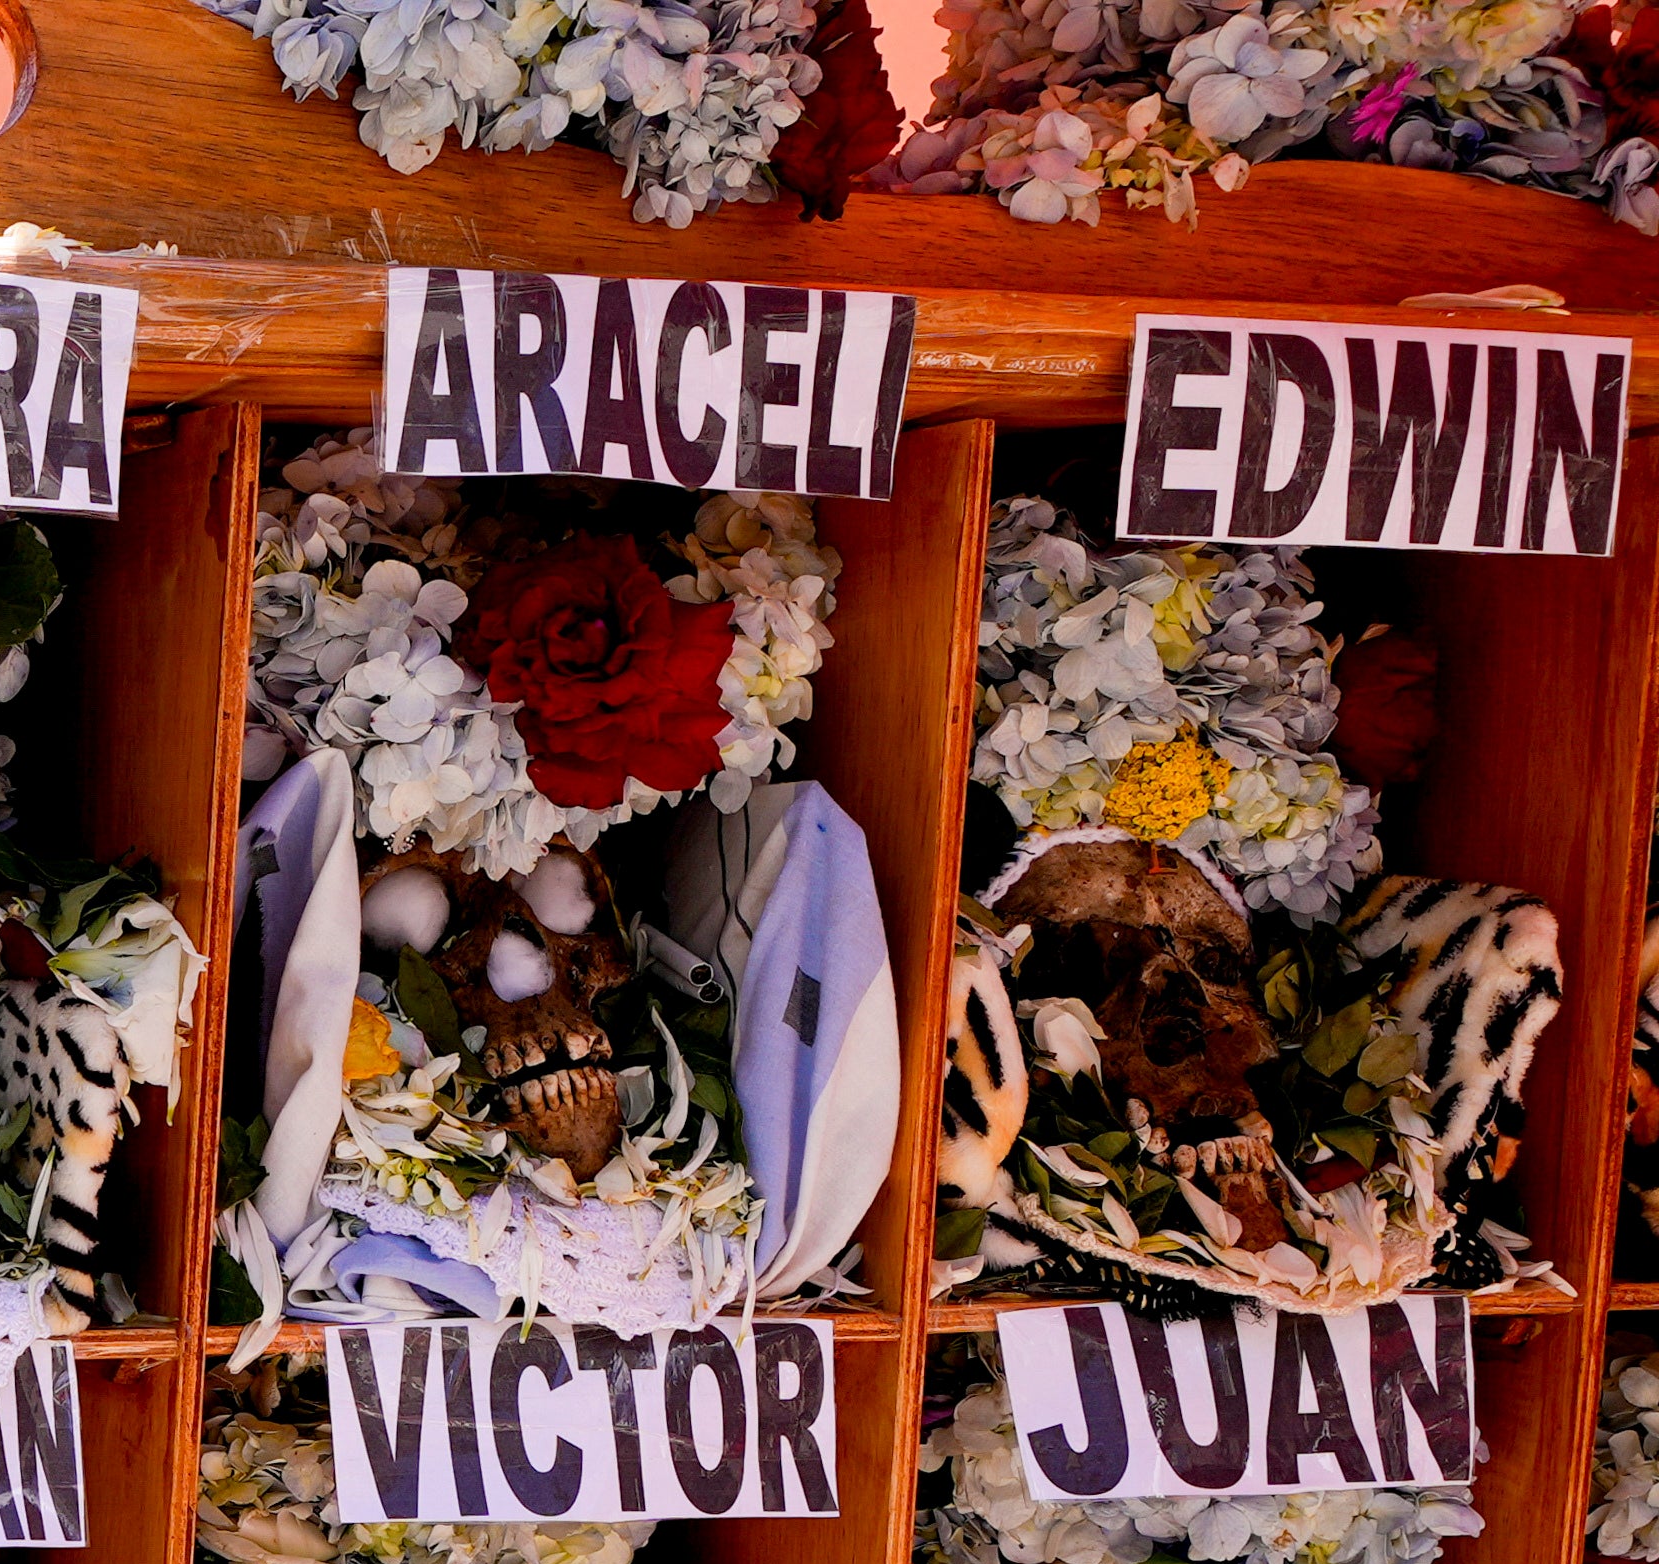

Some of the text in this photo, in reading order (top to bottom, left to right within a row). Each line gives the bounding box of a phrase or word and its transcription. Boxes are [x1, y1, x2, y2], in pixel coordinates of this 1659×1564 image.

[396, 270, 916, 498] ARACELI
[1128, 328, 1625, 551] EDWIN
[340, 1320, 837, 1519] VICTOR
[1027, 1299, 1473, 1496] JUAN
